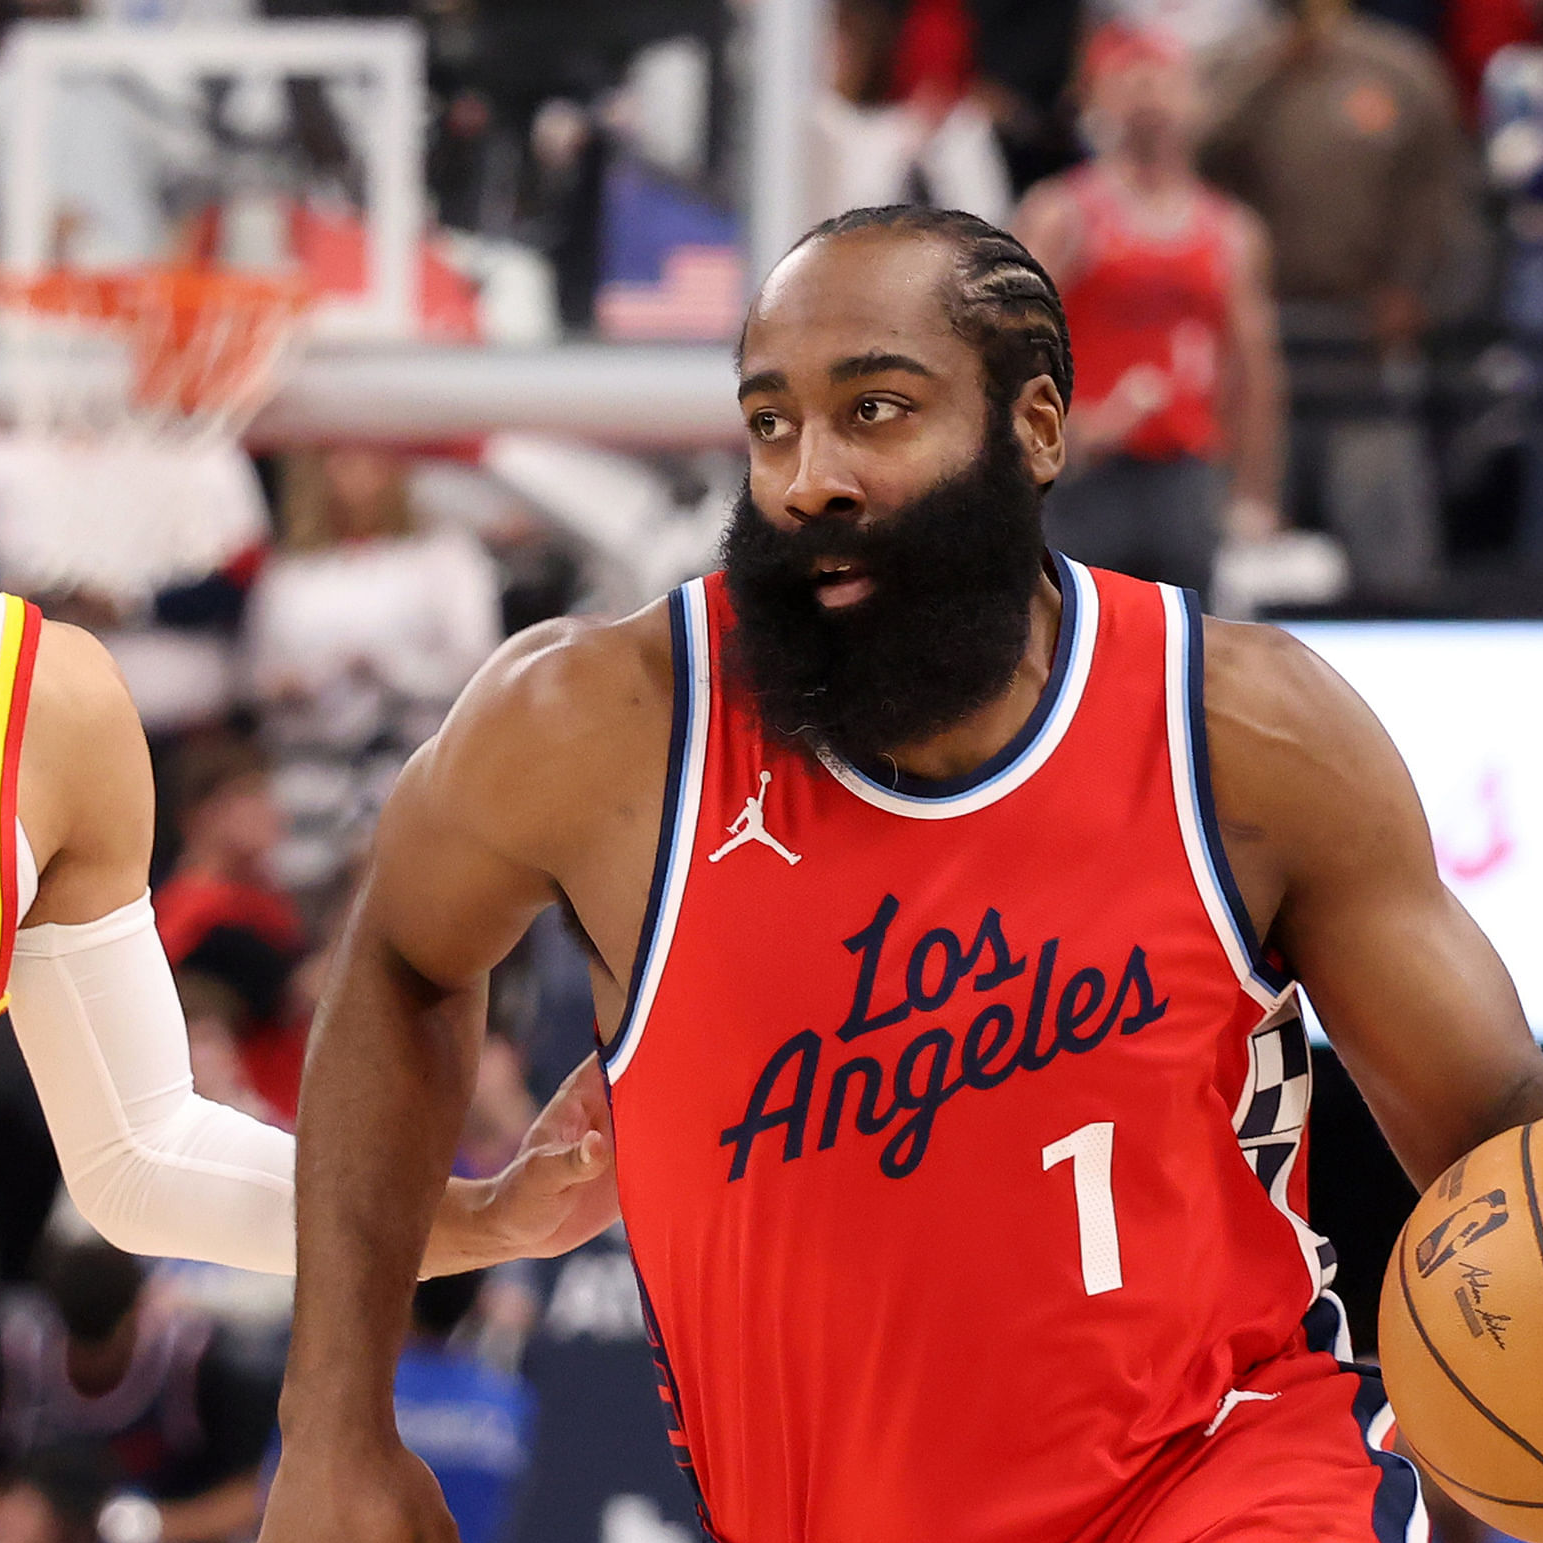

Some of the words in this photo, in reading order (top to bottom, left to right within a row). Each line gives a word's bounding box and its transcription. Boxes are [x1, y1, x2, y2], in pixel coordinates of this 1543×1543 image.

[835, 893, 1027, 1043] Los
[719, 936, 1170, 1183] Angeles
[1042, 1121, 1123, 1297] 1
